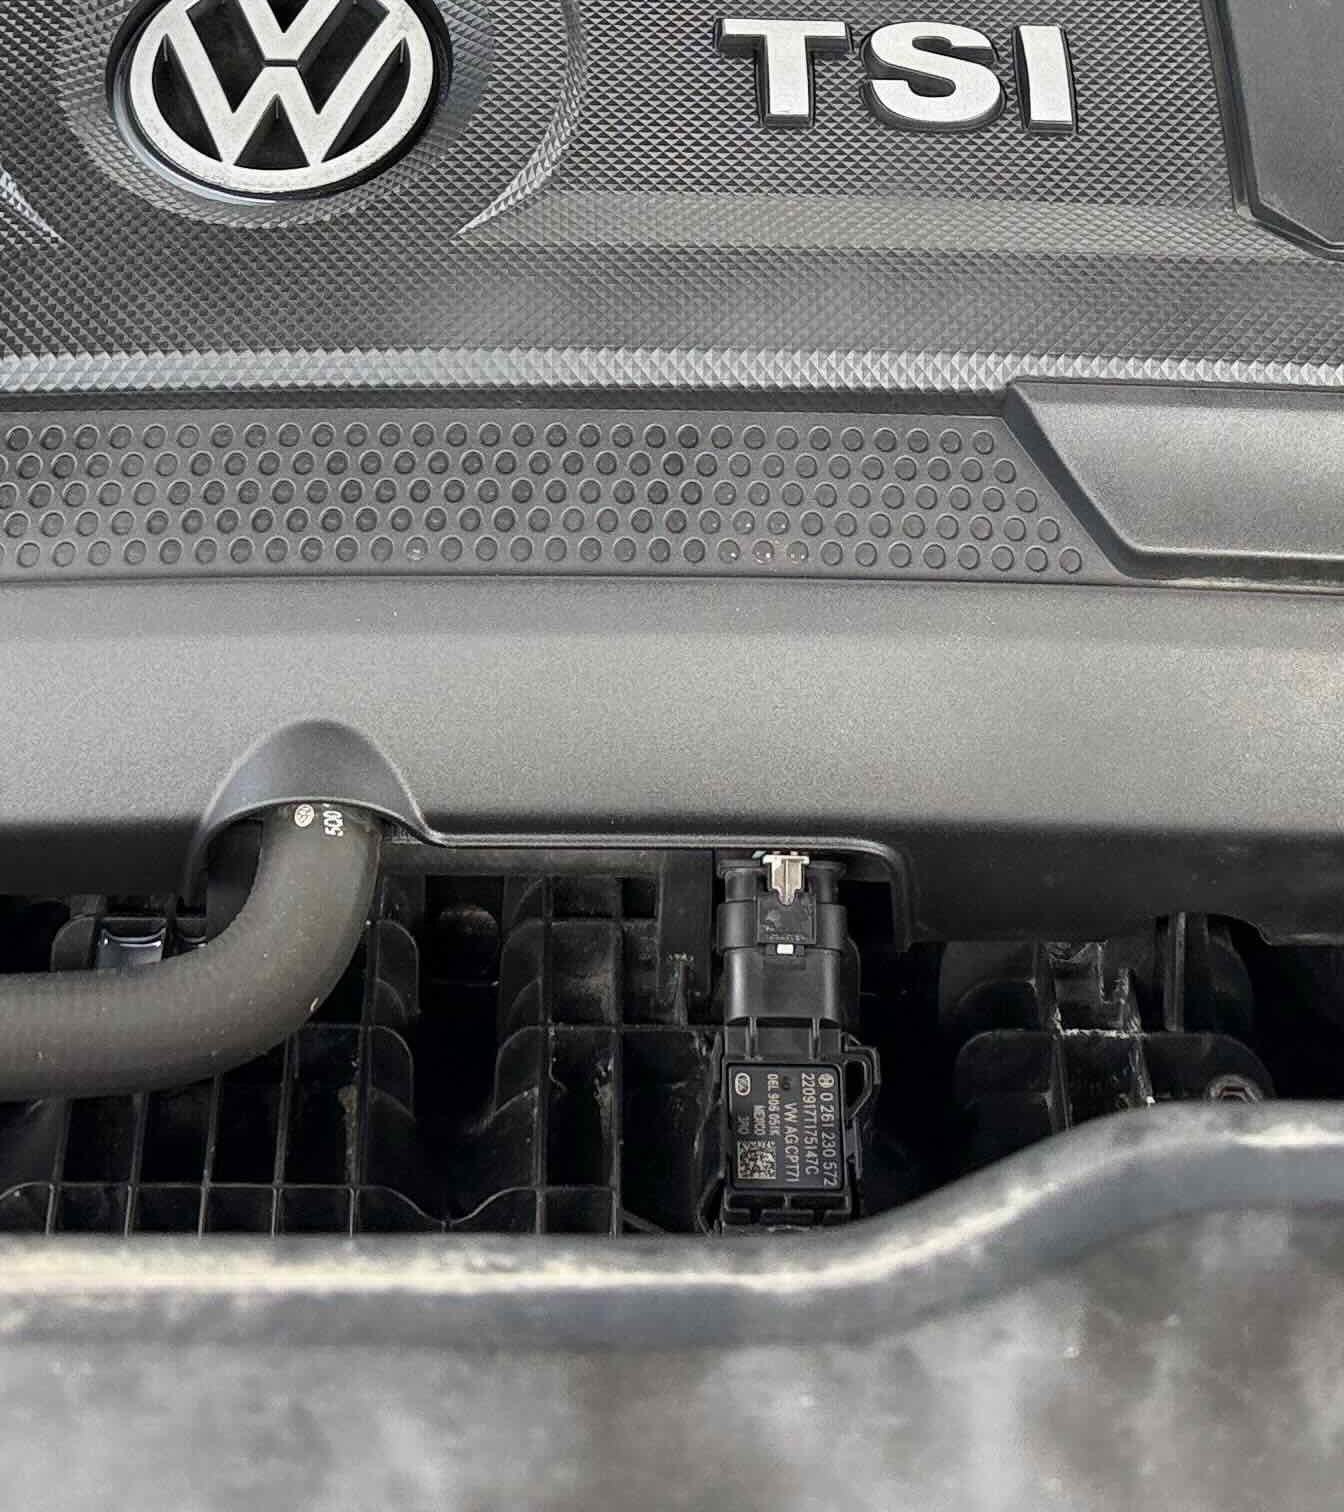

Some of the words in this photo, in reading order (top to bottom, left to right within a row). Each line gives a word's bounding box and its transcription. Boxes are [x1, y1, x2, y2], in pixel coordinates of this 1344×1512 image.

[716, 16, 1078, 134] TSI
[784, 1102, 798, 1123] VW
[821, 1105, 834, 1128] 261
[821, 1132, 836, 1158] 230
[822, 1161, 838, 1186] 572
